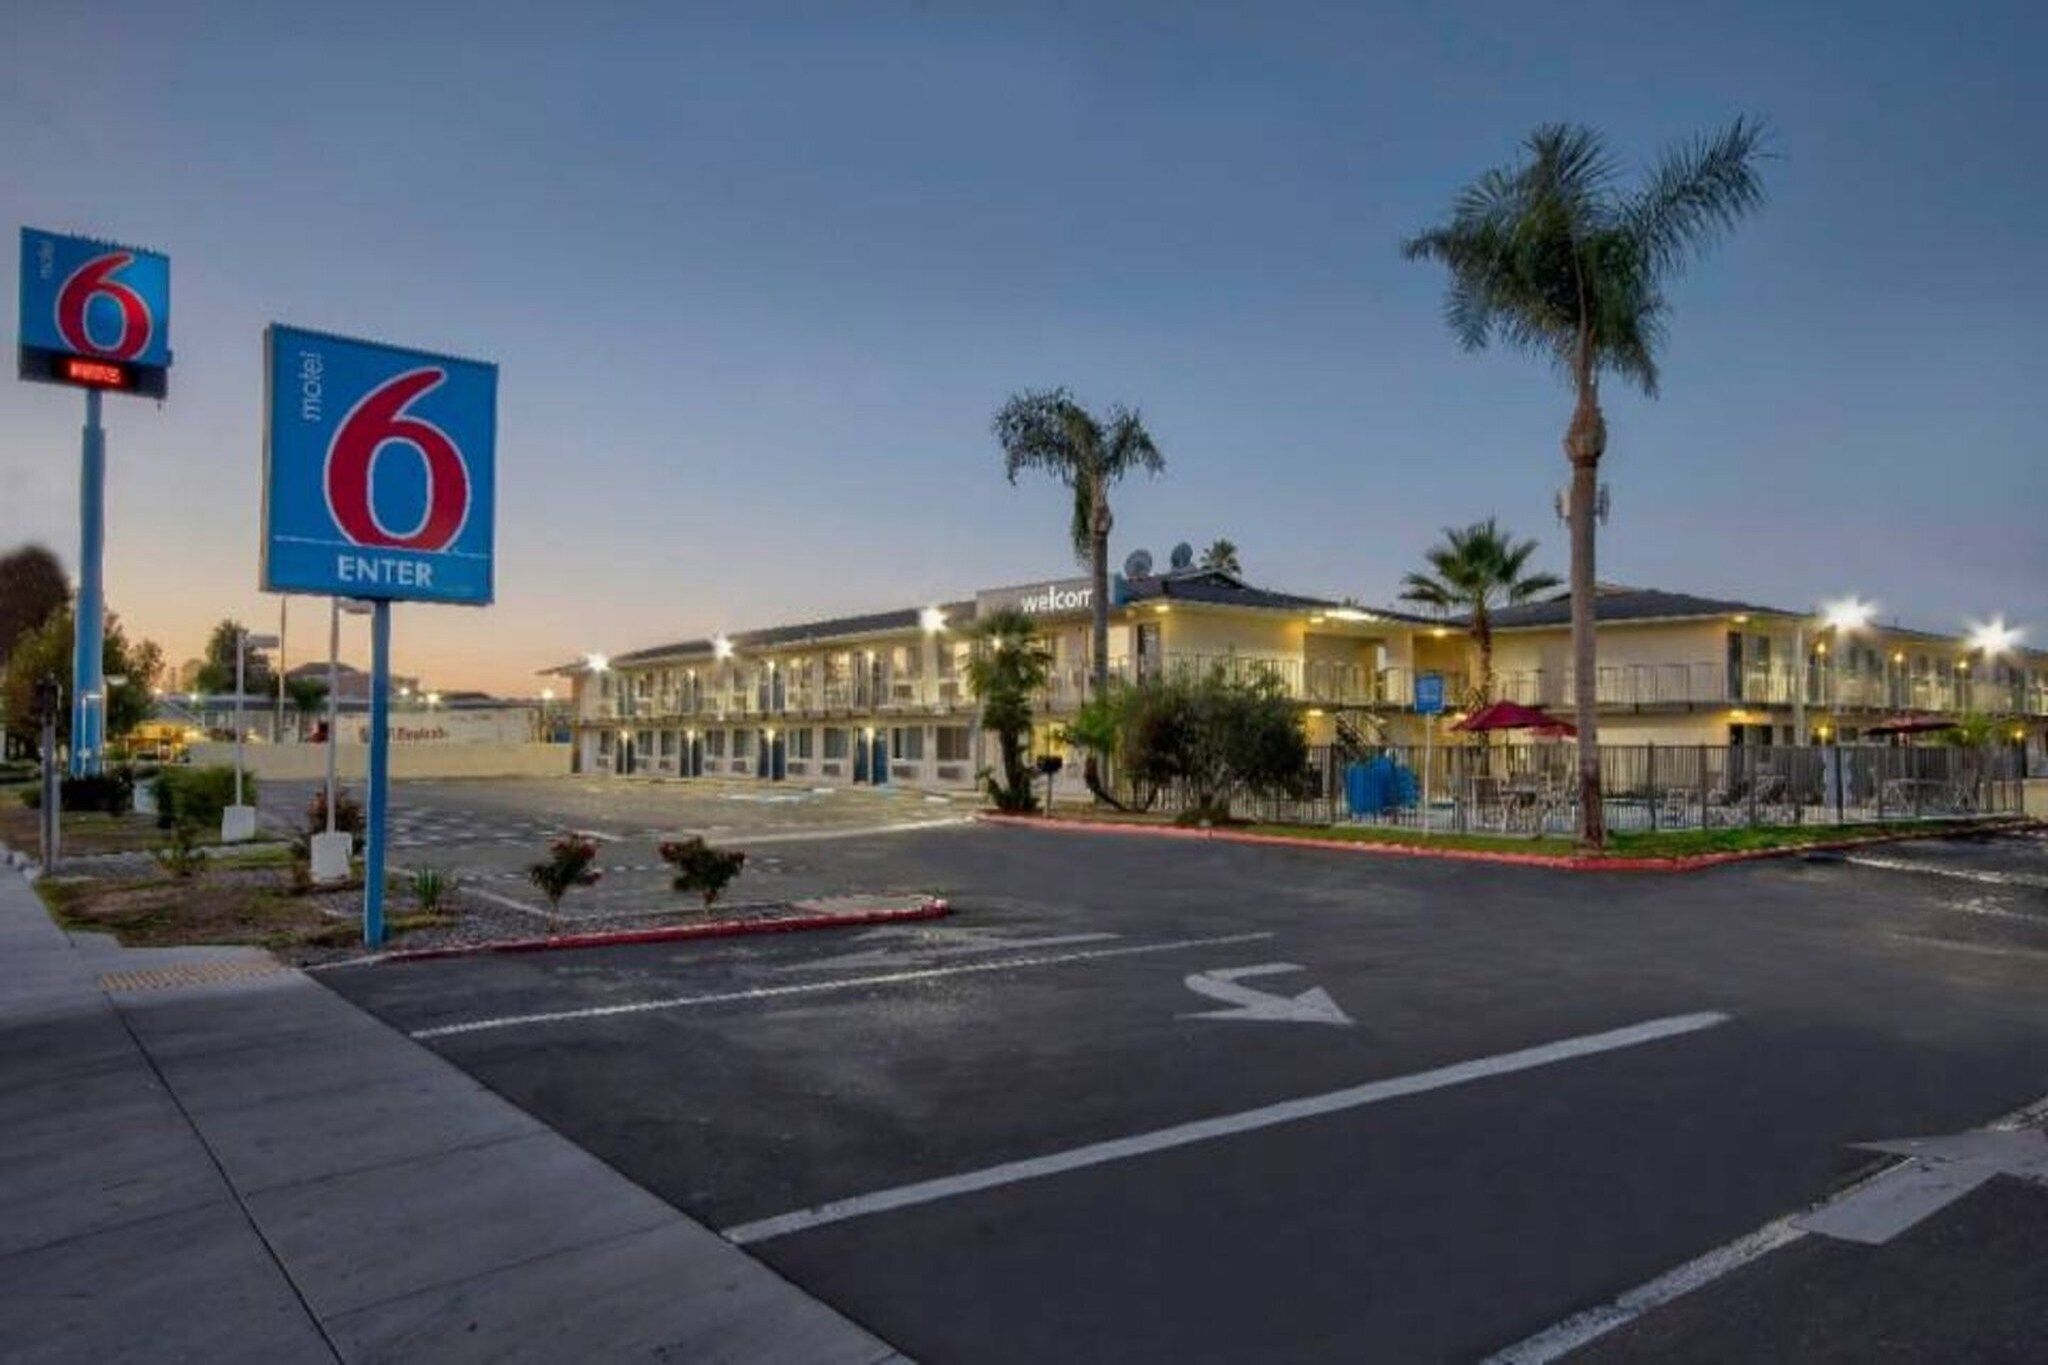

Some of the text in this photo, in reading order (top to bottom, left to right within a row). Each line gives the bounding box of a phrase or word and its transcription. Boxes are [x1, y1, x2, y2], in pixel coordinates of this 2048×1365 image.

[55, 250, 152, 361] 6
[299, 350, 323, 422] motel
[323, 366, 473, 554] 6
[337, 555, 433, 588] ENTER
[1021, 586, 1093, 613] welcom
